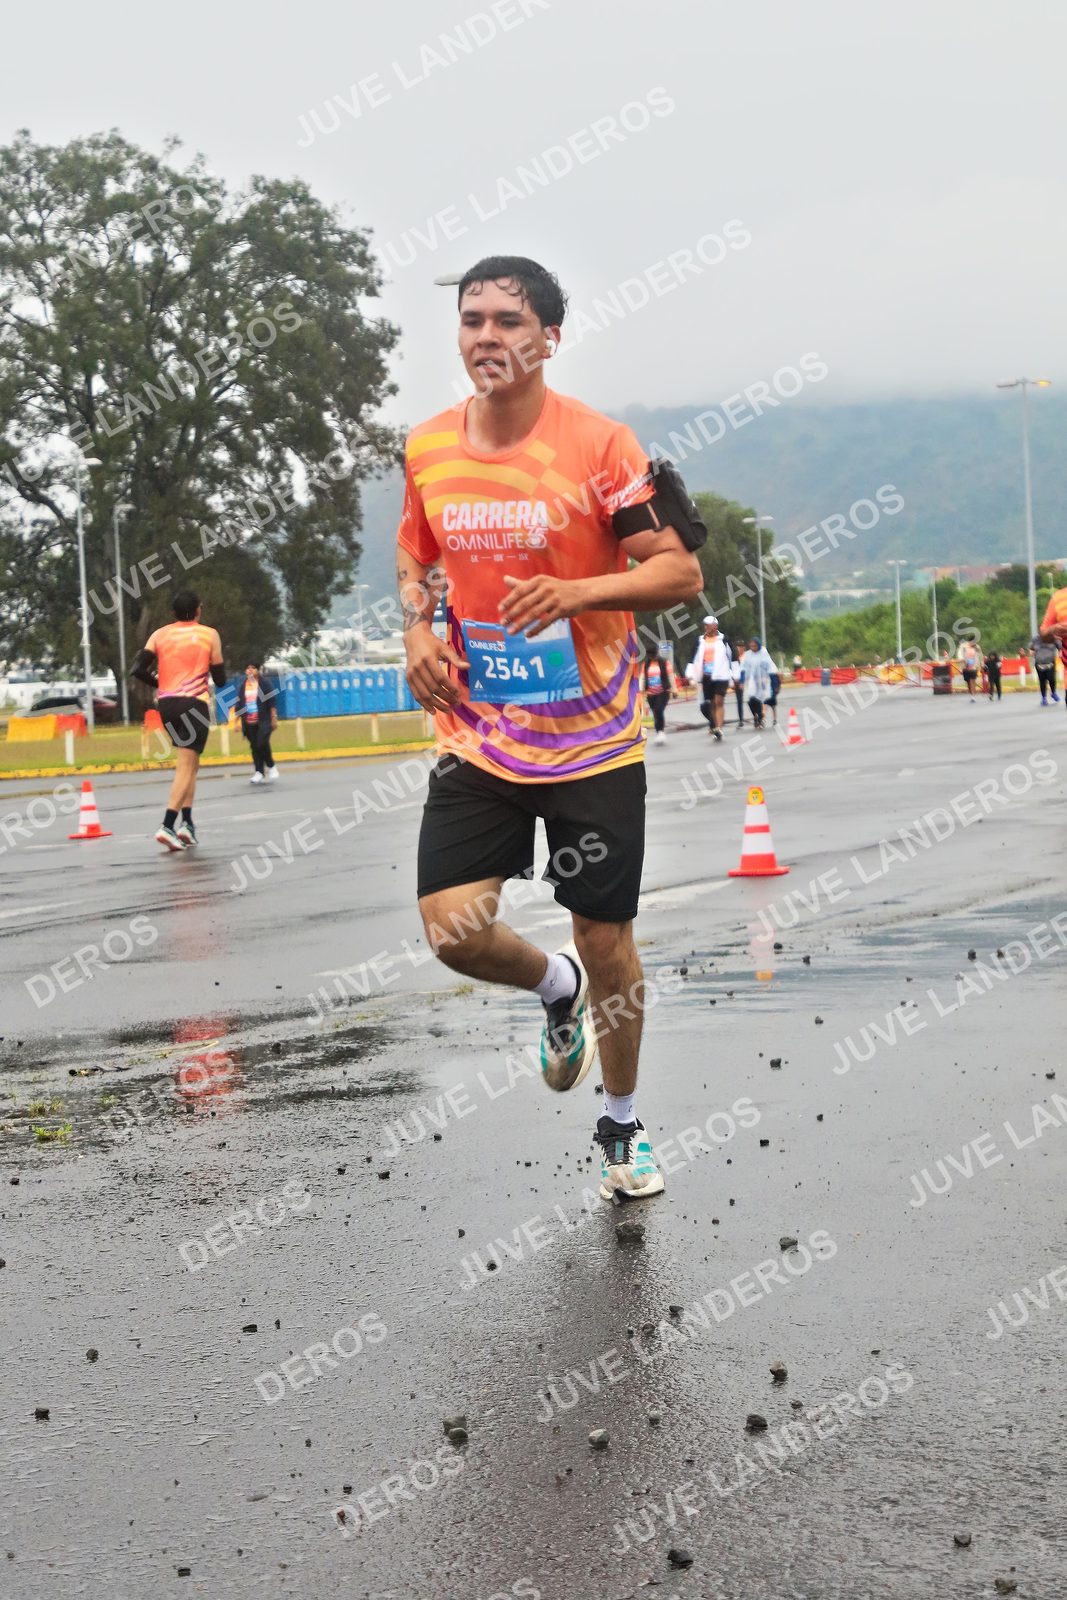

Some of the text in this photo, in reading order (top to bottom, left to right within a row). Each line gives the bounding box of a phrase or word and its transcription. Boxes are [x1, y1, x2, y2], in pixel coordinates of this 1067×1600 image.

[442, 500, 548, 531] CARRERA
[446, 533, 523, 551] OMNILIFE
[482, 656, 545, 680] 2541
